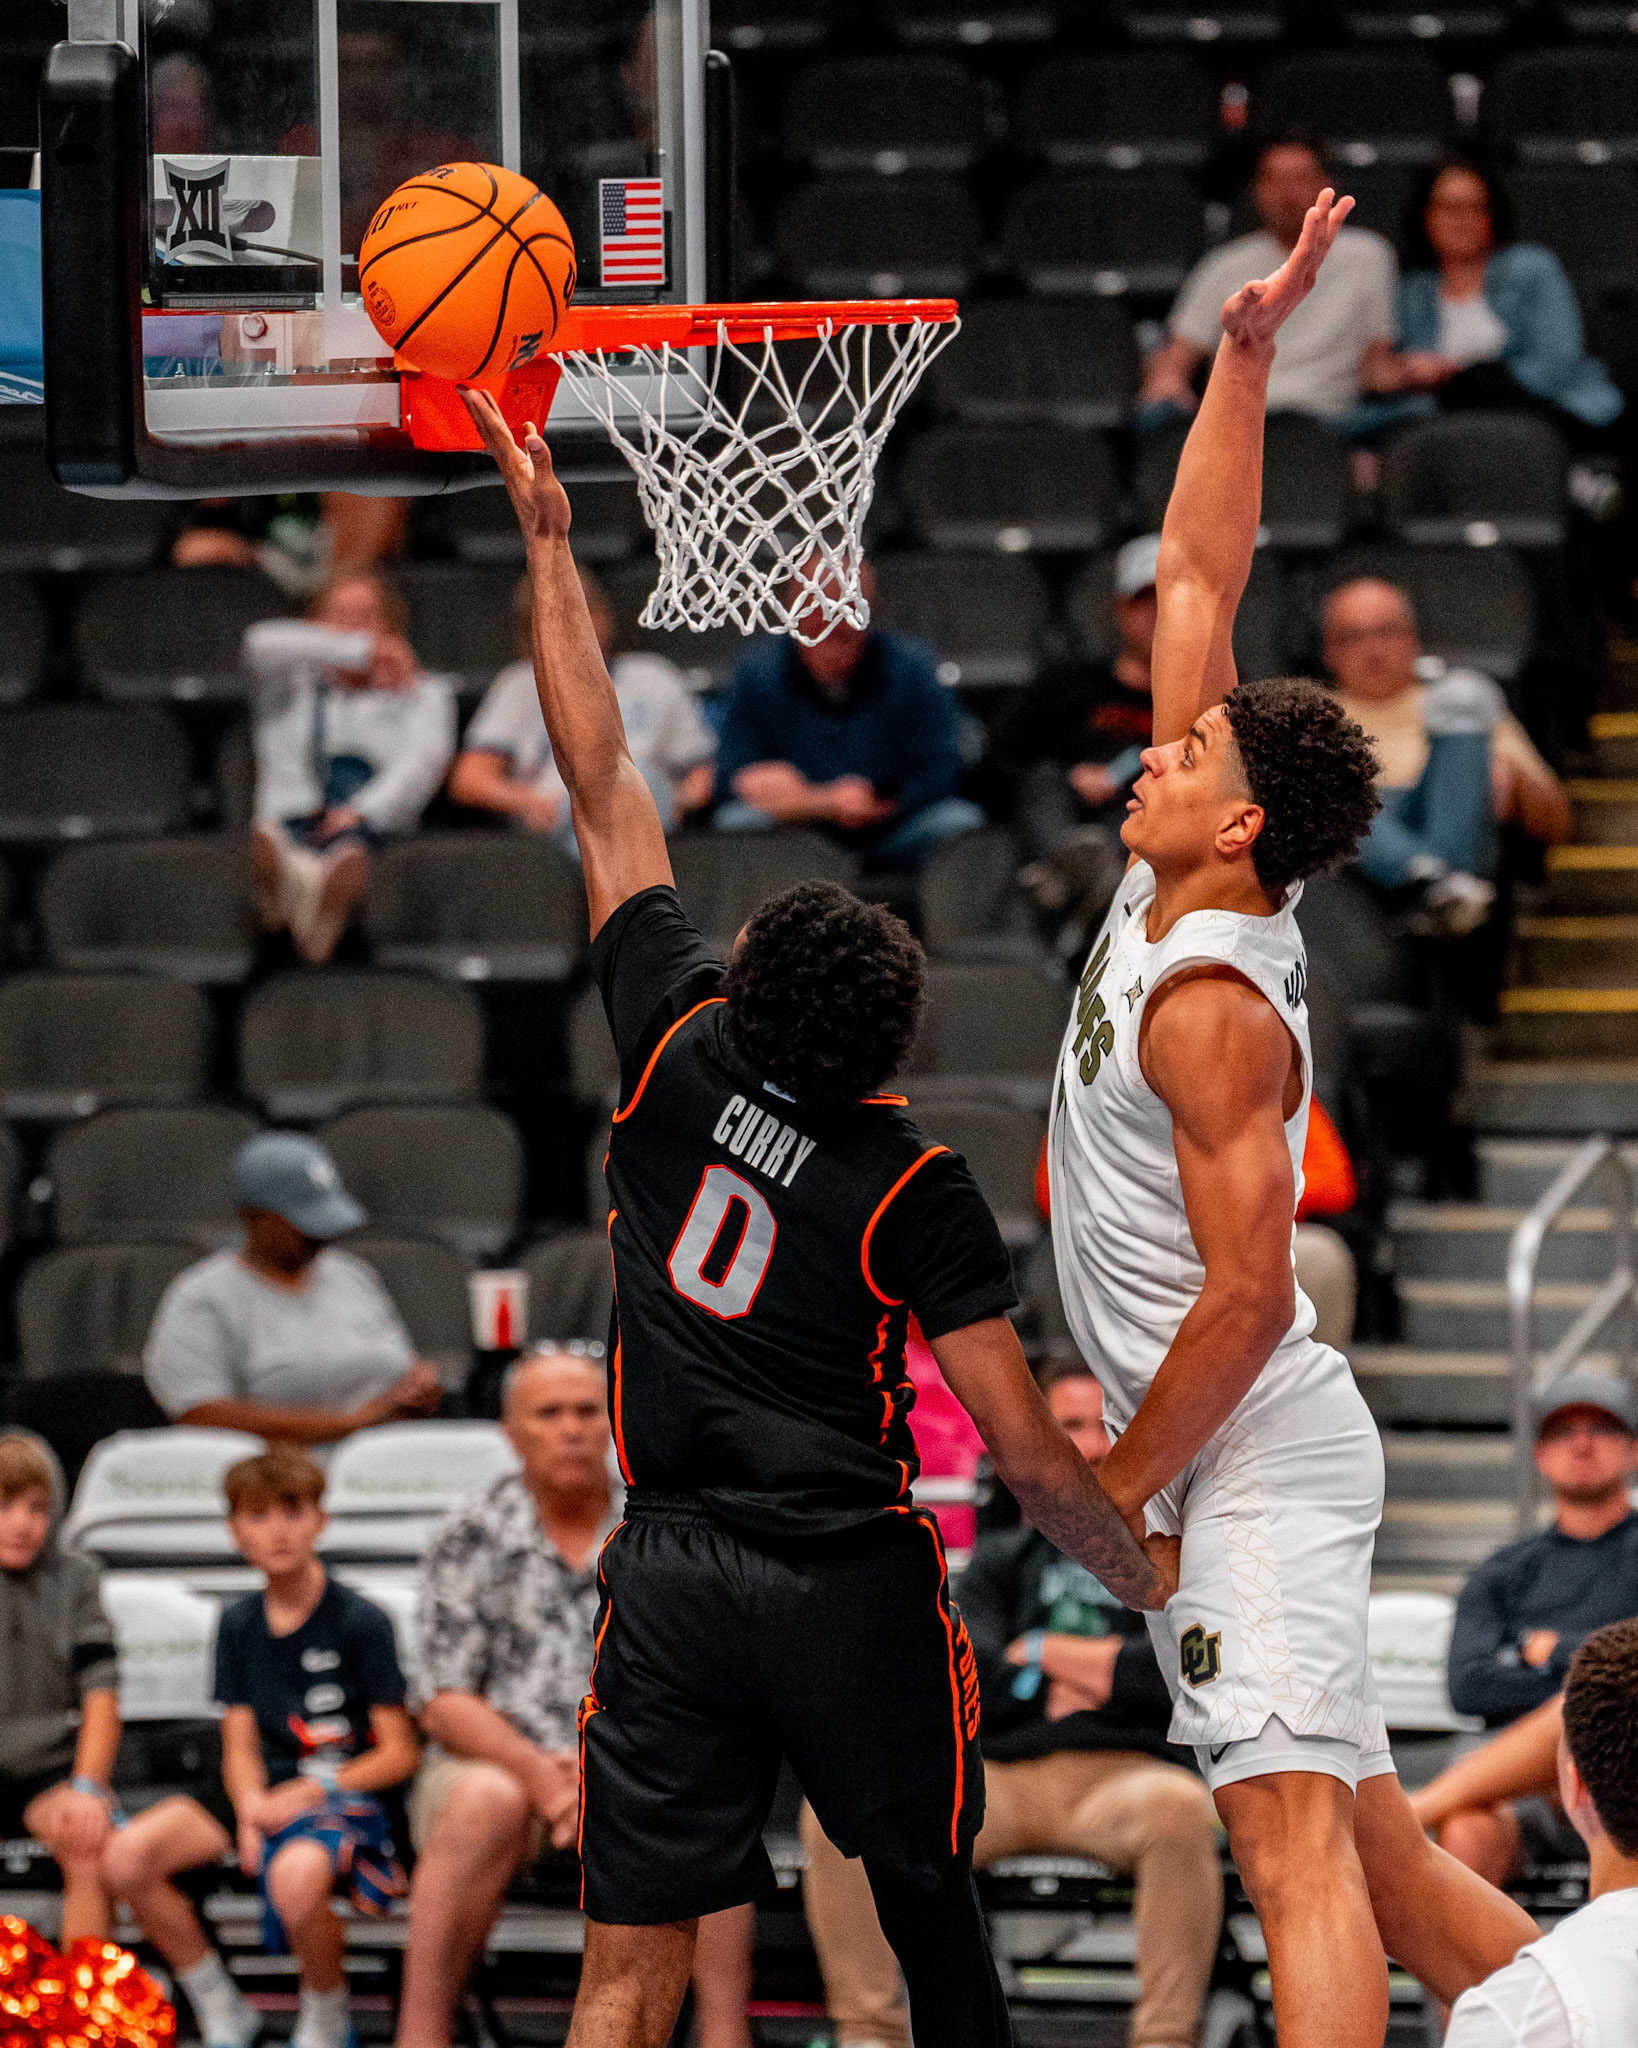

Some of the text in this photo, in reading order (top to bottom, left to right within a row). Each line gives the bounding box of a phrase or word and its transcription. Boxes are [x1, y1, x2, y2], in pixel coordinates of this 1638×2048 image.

[166, 165, 230, 256] XII
[395, 200, 420, 212] NXT
[712, 1094, 817, 1188] CURRY
[667, 1164, 778, 1320] 0
[1179, 1622, 1222, 1690] CU
